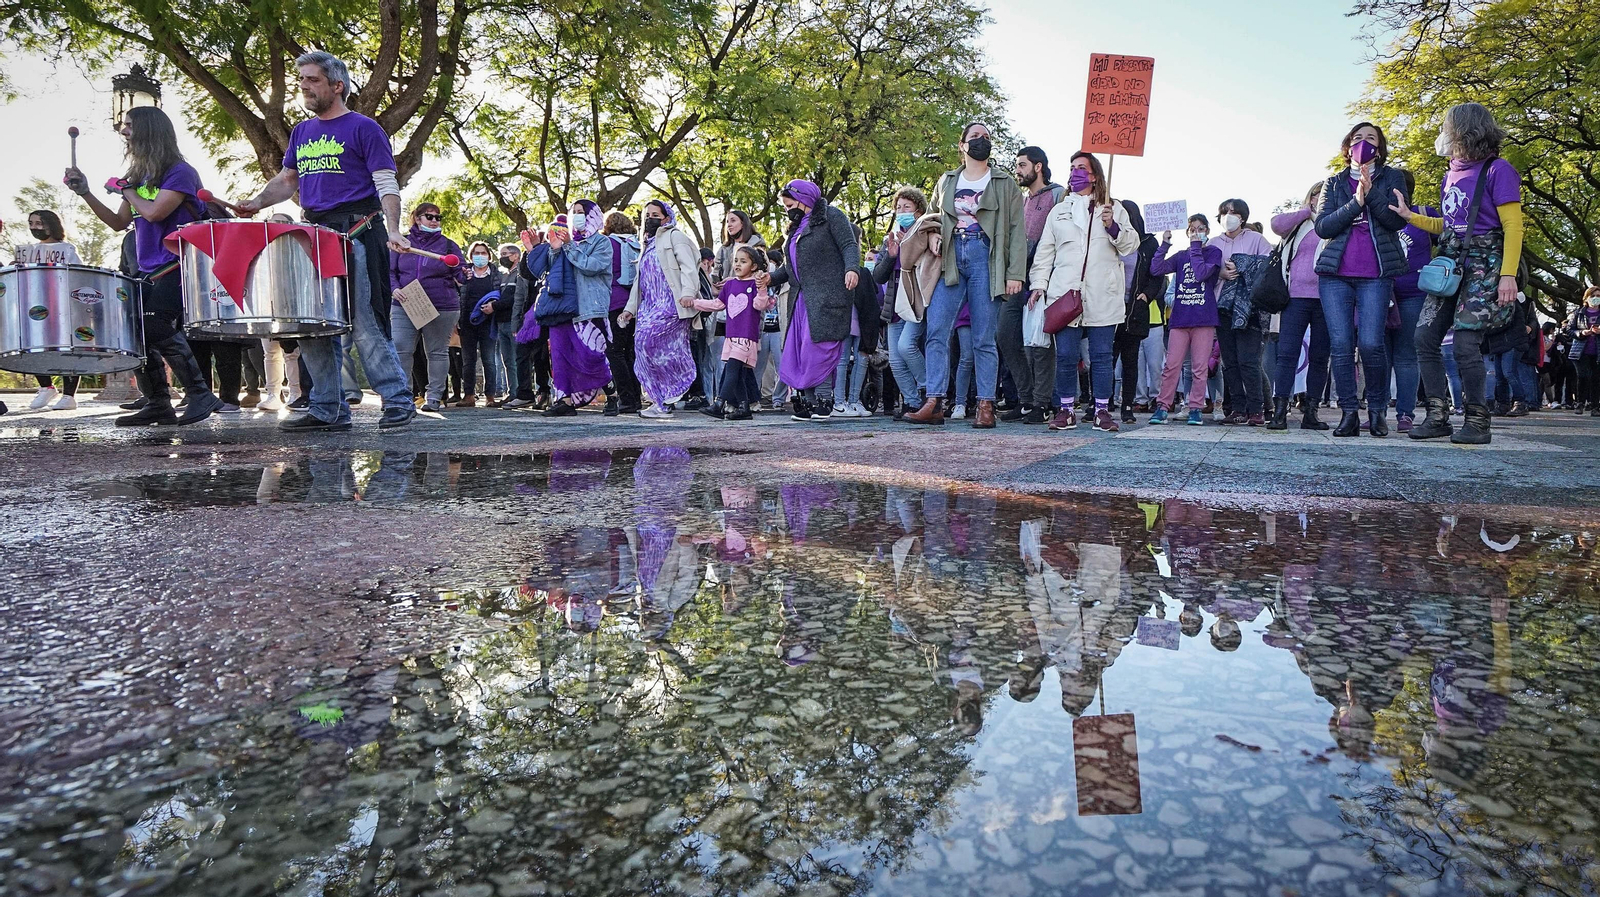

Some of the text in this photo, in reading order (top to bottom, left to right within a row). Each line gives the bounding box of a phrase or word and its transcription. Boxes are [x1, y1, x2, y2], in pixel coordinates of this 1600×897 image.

[1124, 78, 1145, 90] NO
[1090, 92, 1105, 105] ME
[1088, 111, 1105, 125] TU
[1091, 131, 1109, 145] MO
[297, 156, 341, 174] SAMBASUR
[1168, 201, 1181, 209] LAS
[45, 250, 65, 263] HORA
